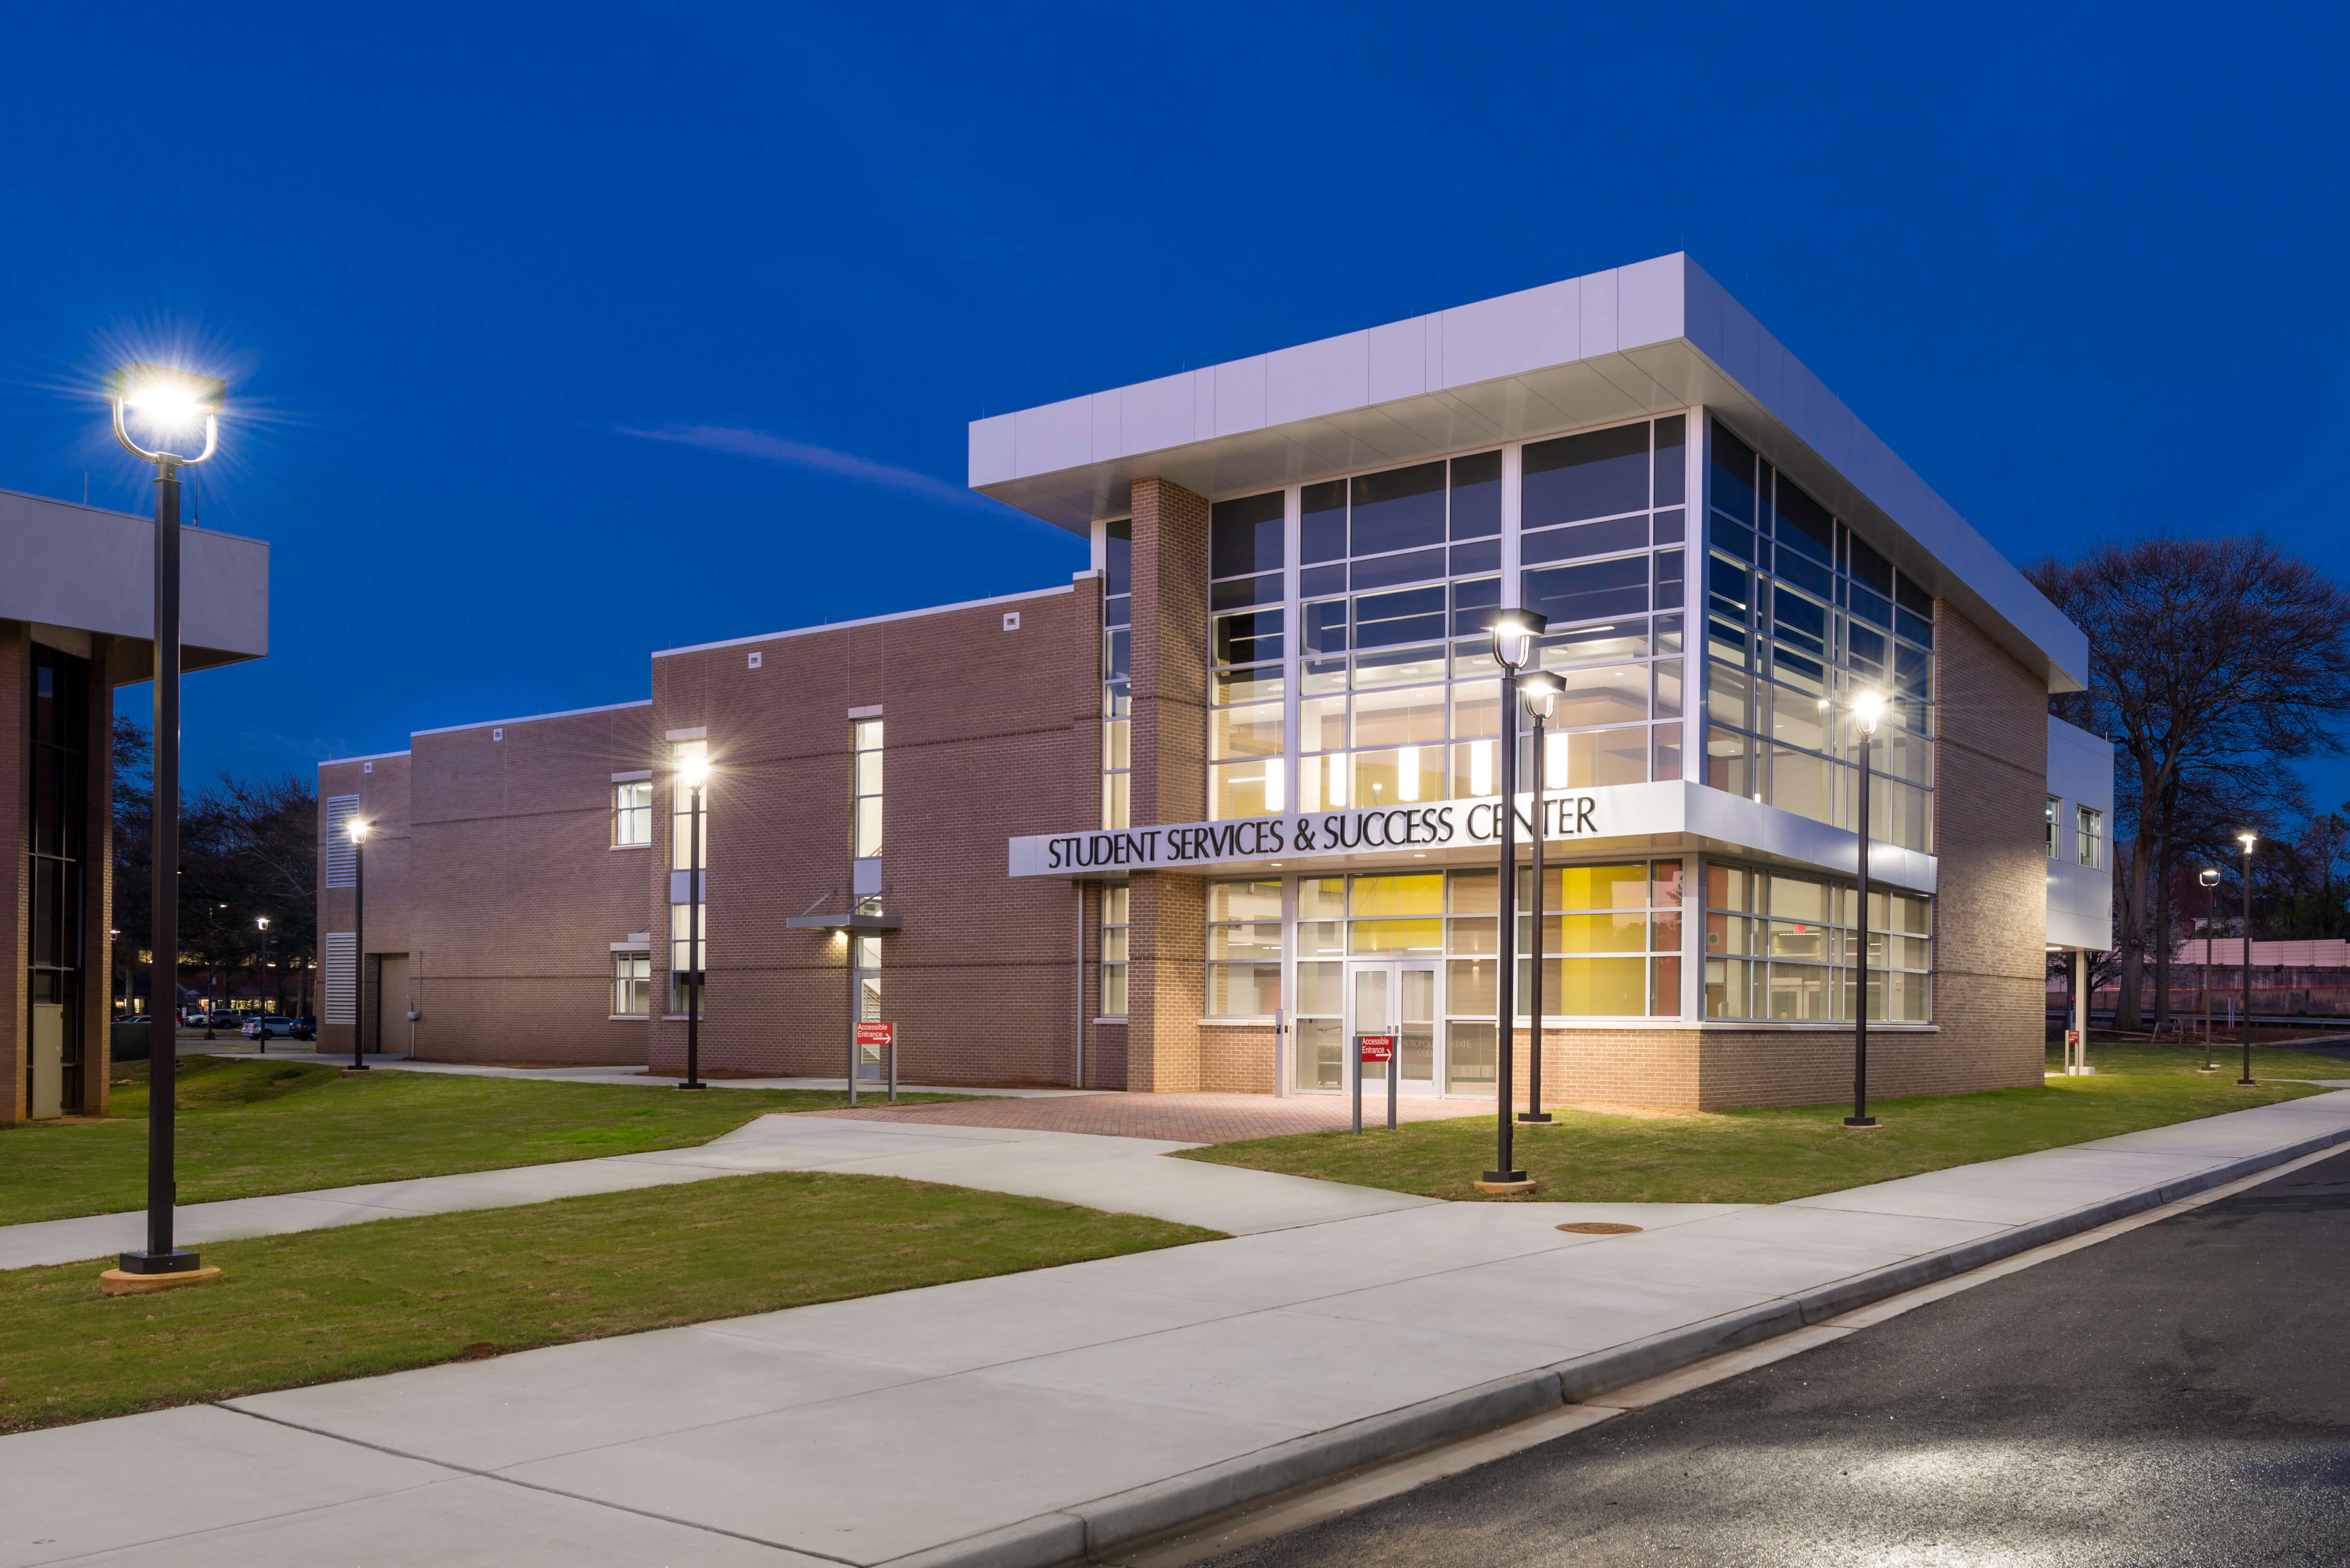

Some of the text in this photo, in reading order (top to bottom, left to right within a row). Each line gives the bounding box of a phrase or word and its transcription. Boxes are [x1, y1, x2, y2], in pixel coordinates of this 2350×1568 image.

[1049, 797, 1598, 869] STUDENT SERVICES & SUCCESS CENTER
